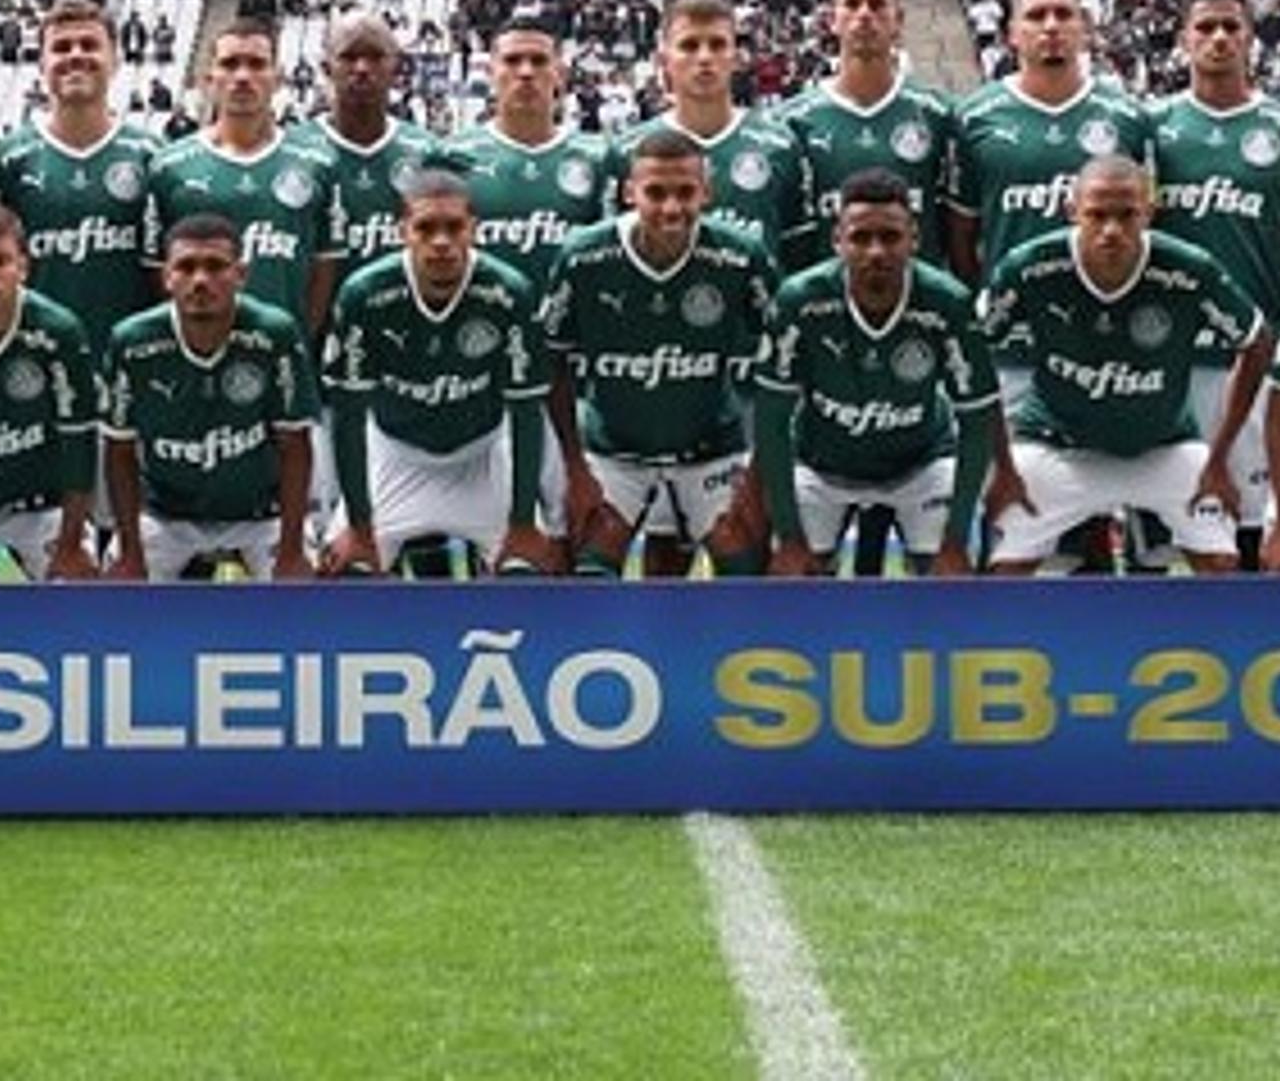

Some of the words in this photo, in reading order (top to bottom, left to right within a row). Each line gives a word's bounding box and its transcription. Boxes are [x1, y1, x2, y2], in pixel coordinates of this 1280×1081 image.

[29, 216, 137, 264] crefisa
[595, 344, 721, 390] crefisa
[1047, 354, 1165, 400] crefisa
[153, 422, 267, 472] crefisa
